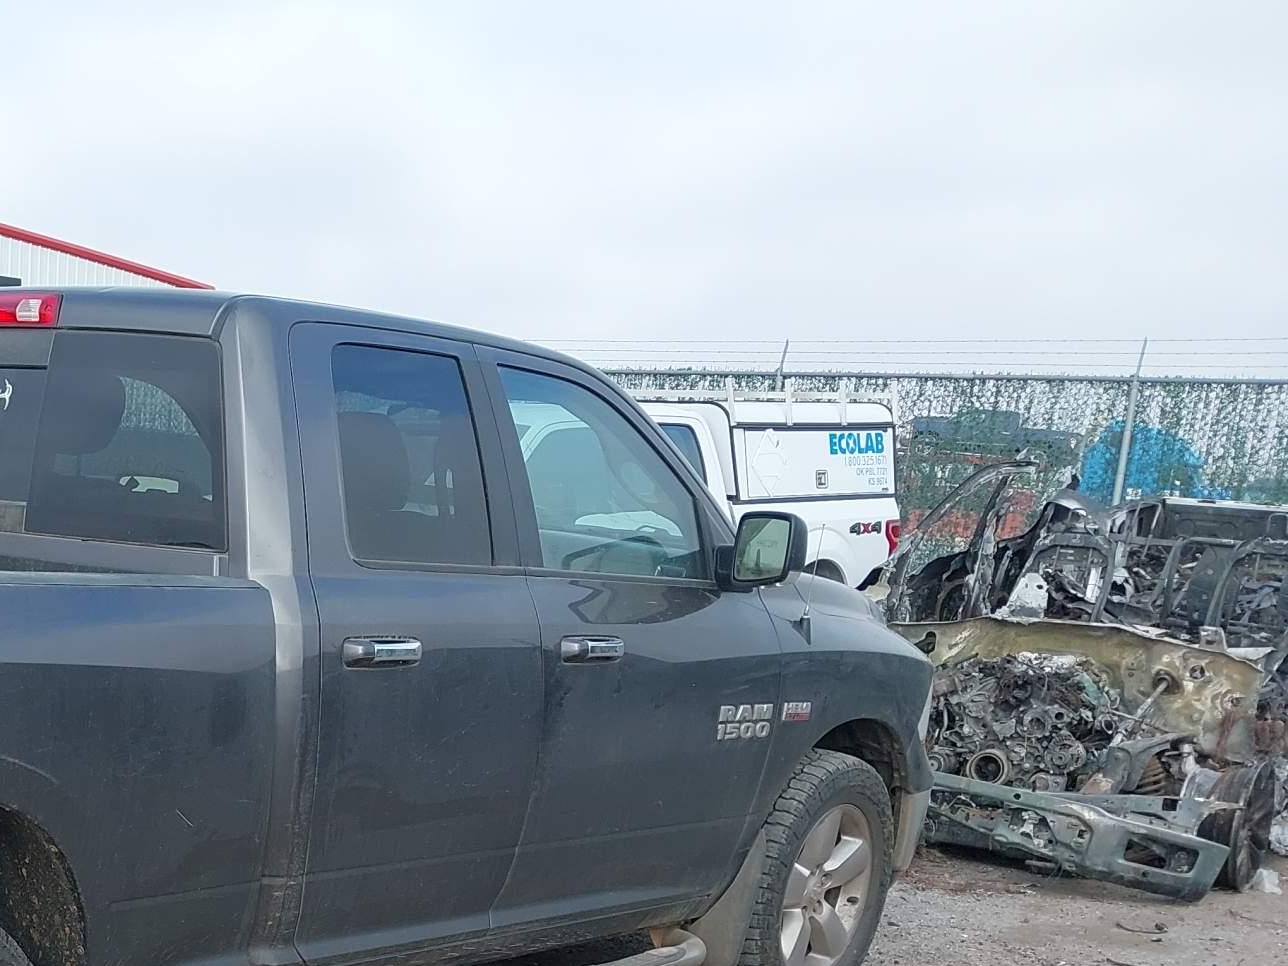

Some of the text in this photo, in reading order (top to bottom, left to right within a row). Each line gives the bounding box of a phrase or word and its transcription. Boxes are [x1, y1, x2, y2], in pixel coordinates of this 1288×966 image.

[828, 432, 885, 455] ECOLAB
[719, 703, 774, 722] RAM
[717, 721, 771, 741] 1500
